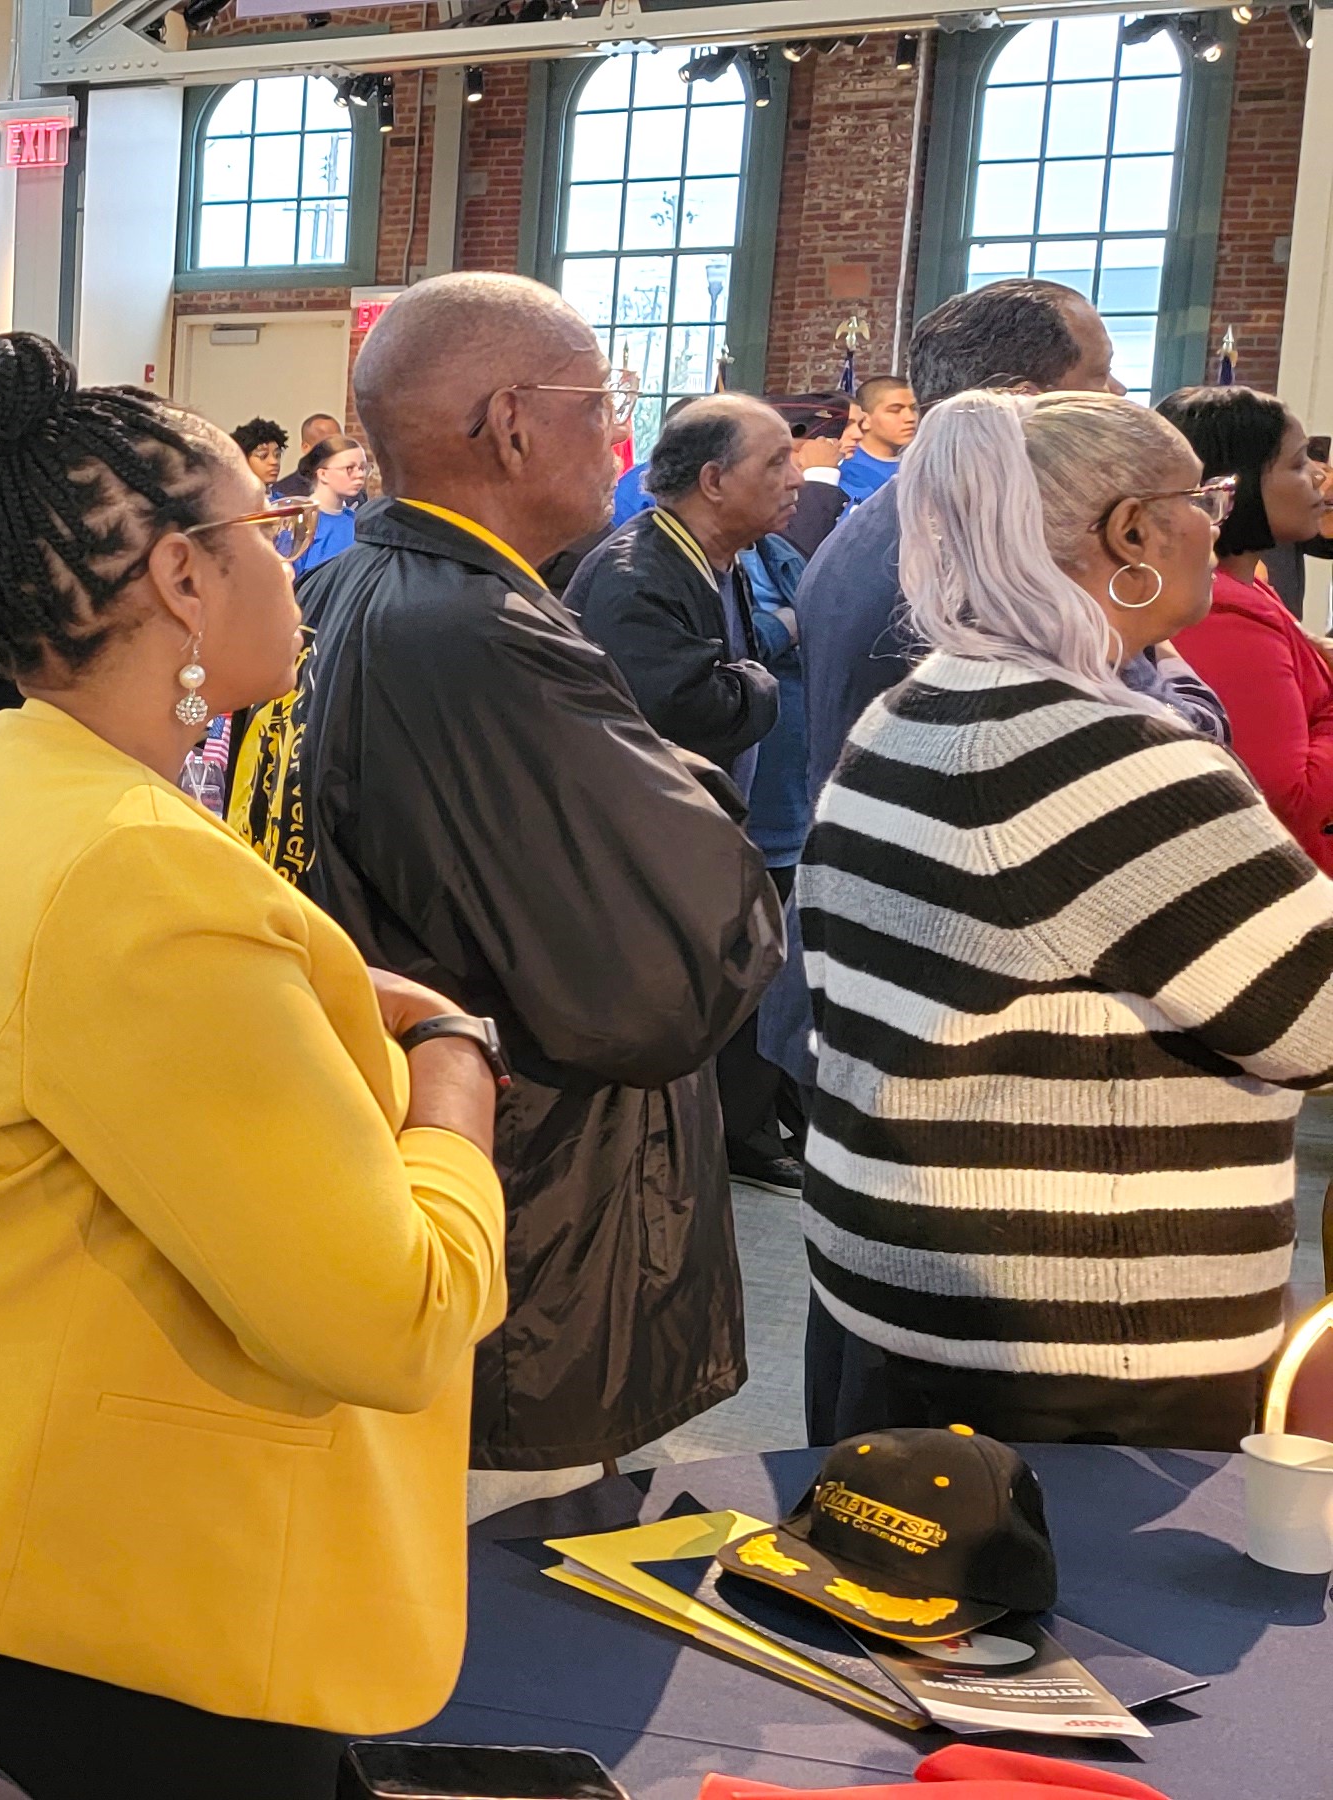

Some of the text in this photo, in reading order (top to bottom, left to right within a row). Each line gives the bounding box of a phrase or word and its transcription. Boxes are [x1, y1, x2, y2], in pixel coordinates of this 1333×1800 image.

[6, 122, 63, 164] EXIT
[358, 302, 392, 329] EX
[827, 1493, 921, 1535] NABVETS
[851, 1518, 929, 1555] Commander
[921, 1679, 998, 1695] EDITION
[999, 1687, 1096, 1697] VETERANS
